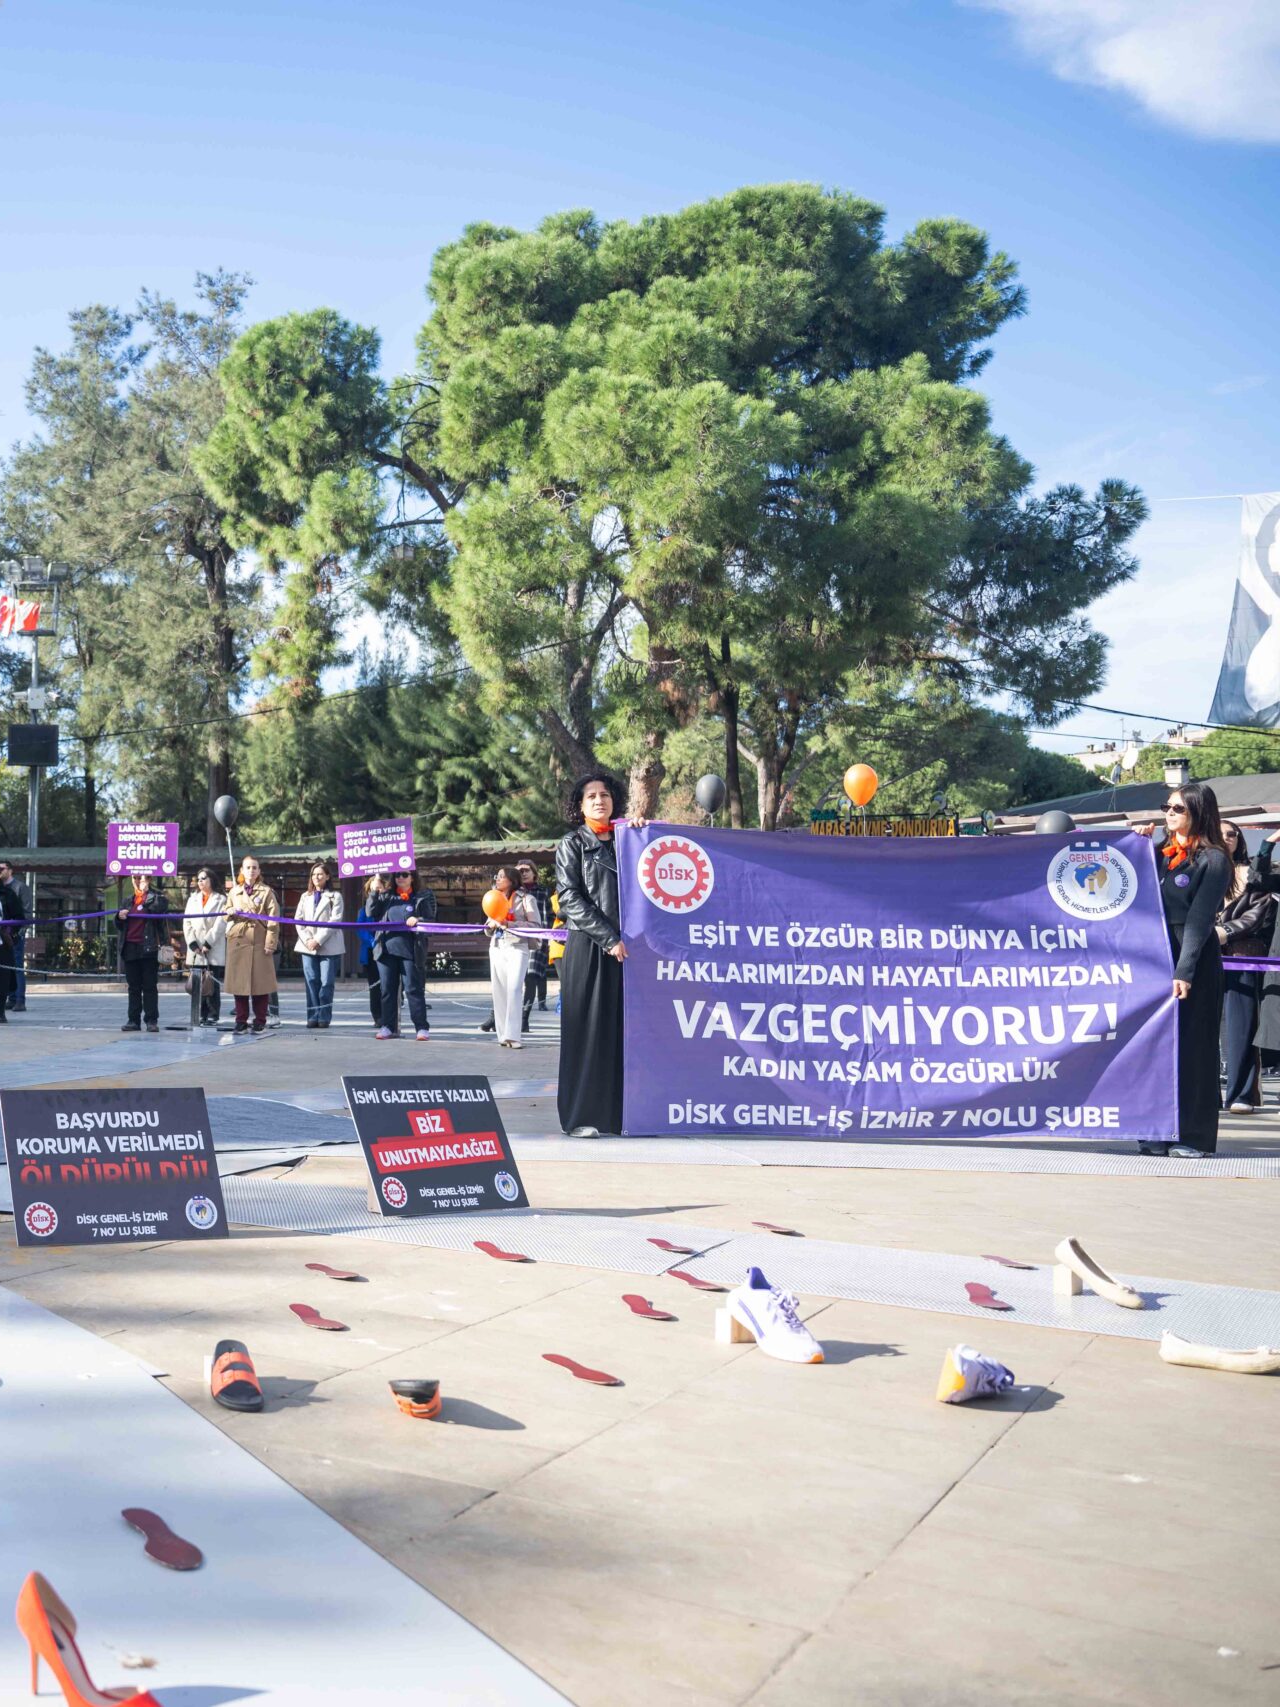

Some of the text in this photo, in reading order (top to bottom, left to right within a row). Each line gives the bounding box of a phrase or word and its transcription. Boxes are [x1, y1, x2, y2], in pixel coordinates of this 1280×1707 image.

[117, 843, 166, 859] EĞİTİM
[344, 842, 407, 859] MÜCADELE
[1069, 852, 1109, 864] GENEL-İŞ
[658, 863, 694, 880] DİSK
[688, 920, 1088, 953] EŞİT VE ÖZGÜR BİR DÜNYA İÇİN
[656, 960, 1133, 988] HAKLARIMIZDAN HAYATLARIMIZDAN
[672, 997, 1118, 1051] VAZGEÇMİYORUZ!
[723, 1055, 1061, 1086] KADIN YAŞAM ÖZGÜRLÜK
[352, 1088, 490, 1105] İSMİ GAZETEYE YAZILDI
[56, 1111, 160, 1131] BAŞVURDU
[416, 1112, 445, 1134] BİZ
[668, 1099, 1120, 1132] DİSK GENEL-İŞ İZMİR 7 NOLU ŞUBE
[16, 1130, 205, 1155] KORUMA VERİLMEDİ
[378, 1138, 498, 1167] UNUTMAYACAĞIZ!
[419, 1185, 485, 1197] DİSK GENEL-İŞ İZMİR
[433, 1200, 438, 1208] 7
[452, 1199, 461, 1207] LU
[461, 1198, 479, 1208] ŞUBE
[33, 1214, 50, 1223] DİSK
[76, 1211, 169, 1225] DİSK GENEL-İŞ İZMİR
[91, 1228, 98, 1237] 7
[119, 1227, 131, 1236] LU
[132, 1225, 157, 1237] ŞUBE
